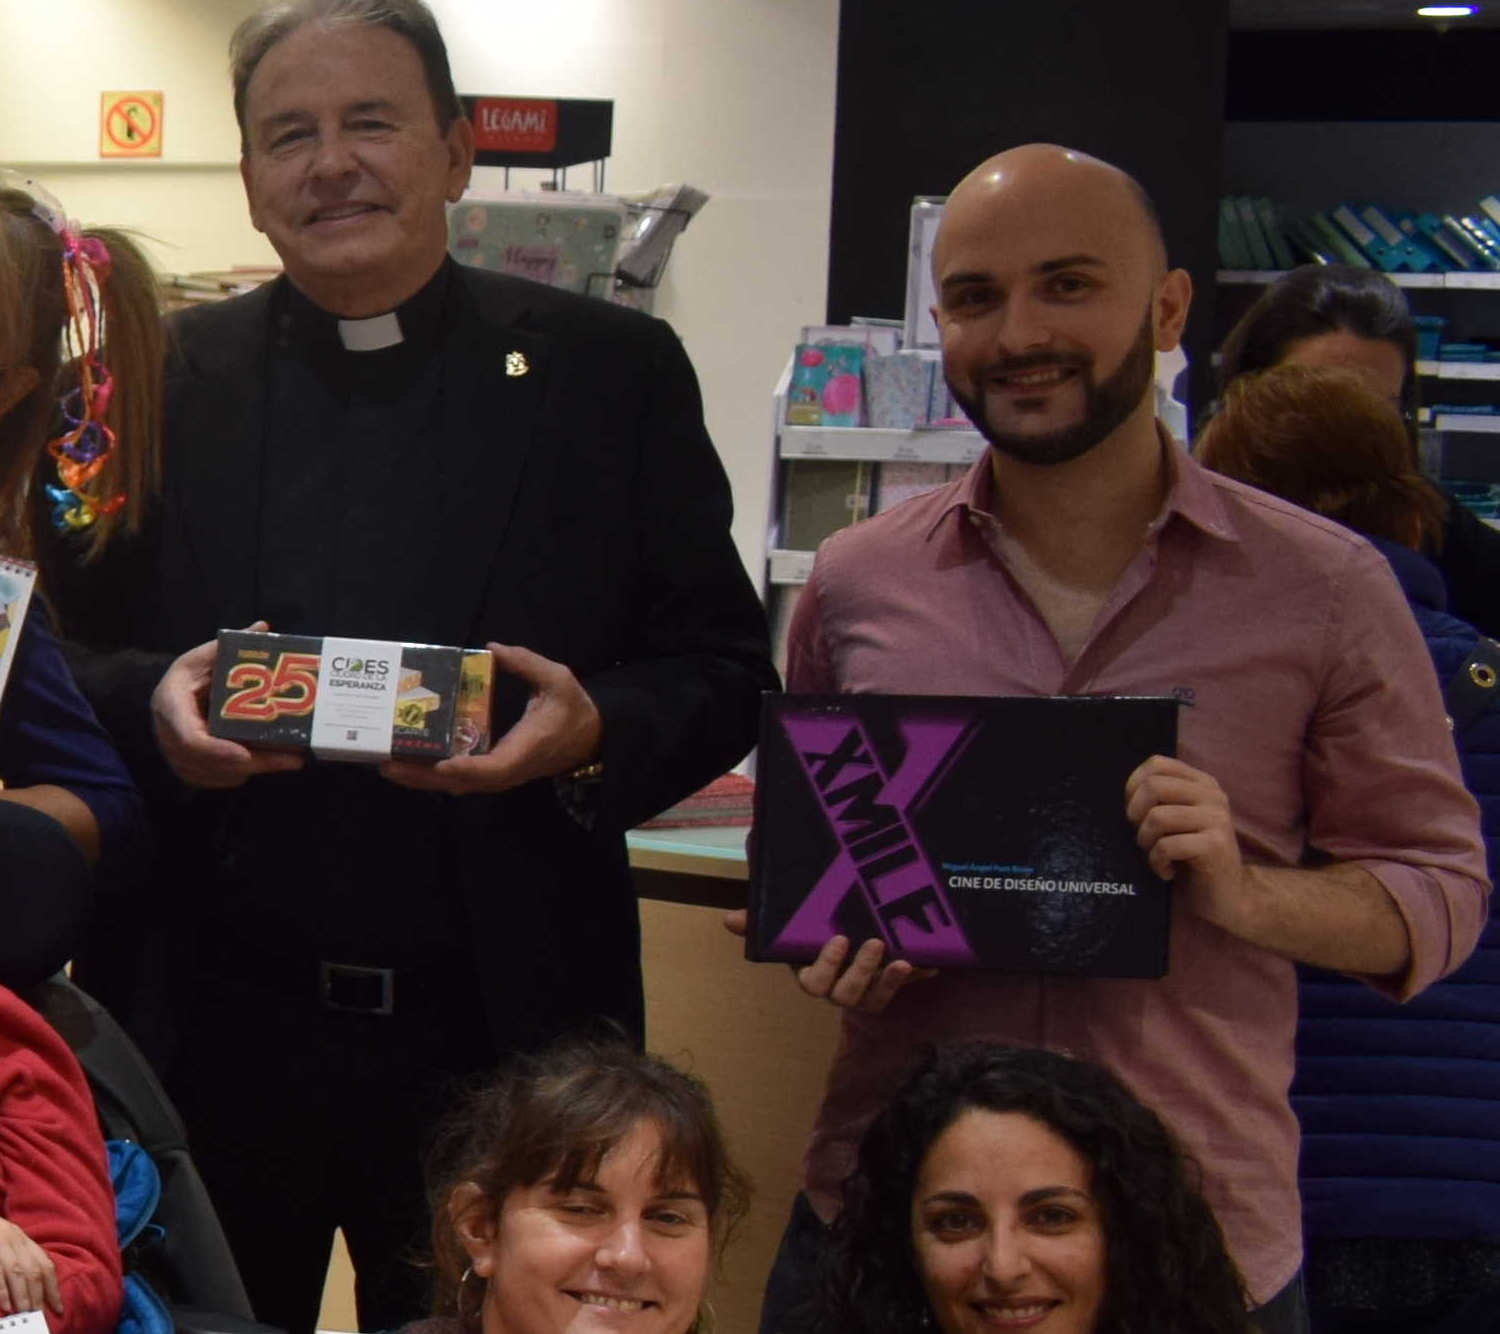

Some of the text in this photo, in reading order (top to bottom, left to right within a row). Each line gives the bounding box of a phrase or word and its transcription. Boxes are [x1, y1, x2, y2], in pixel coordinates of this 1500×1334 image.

[219, 652, 321, 722] 25
[328, 678, 388, 692] ESPERANZA
[948, 874, 1137, 896] CINE DE DISEÑO UNIVERSAL
